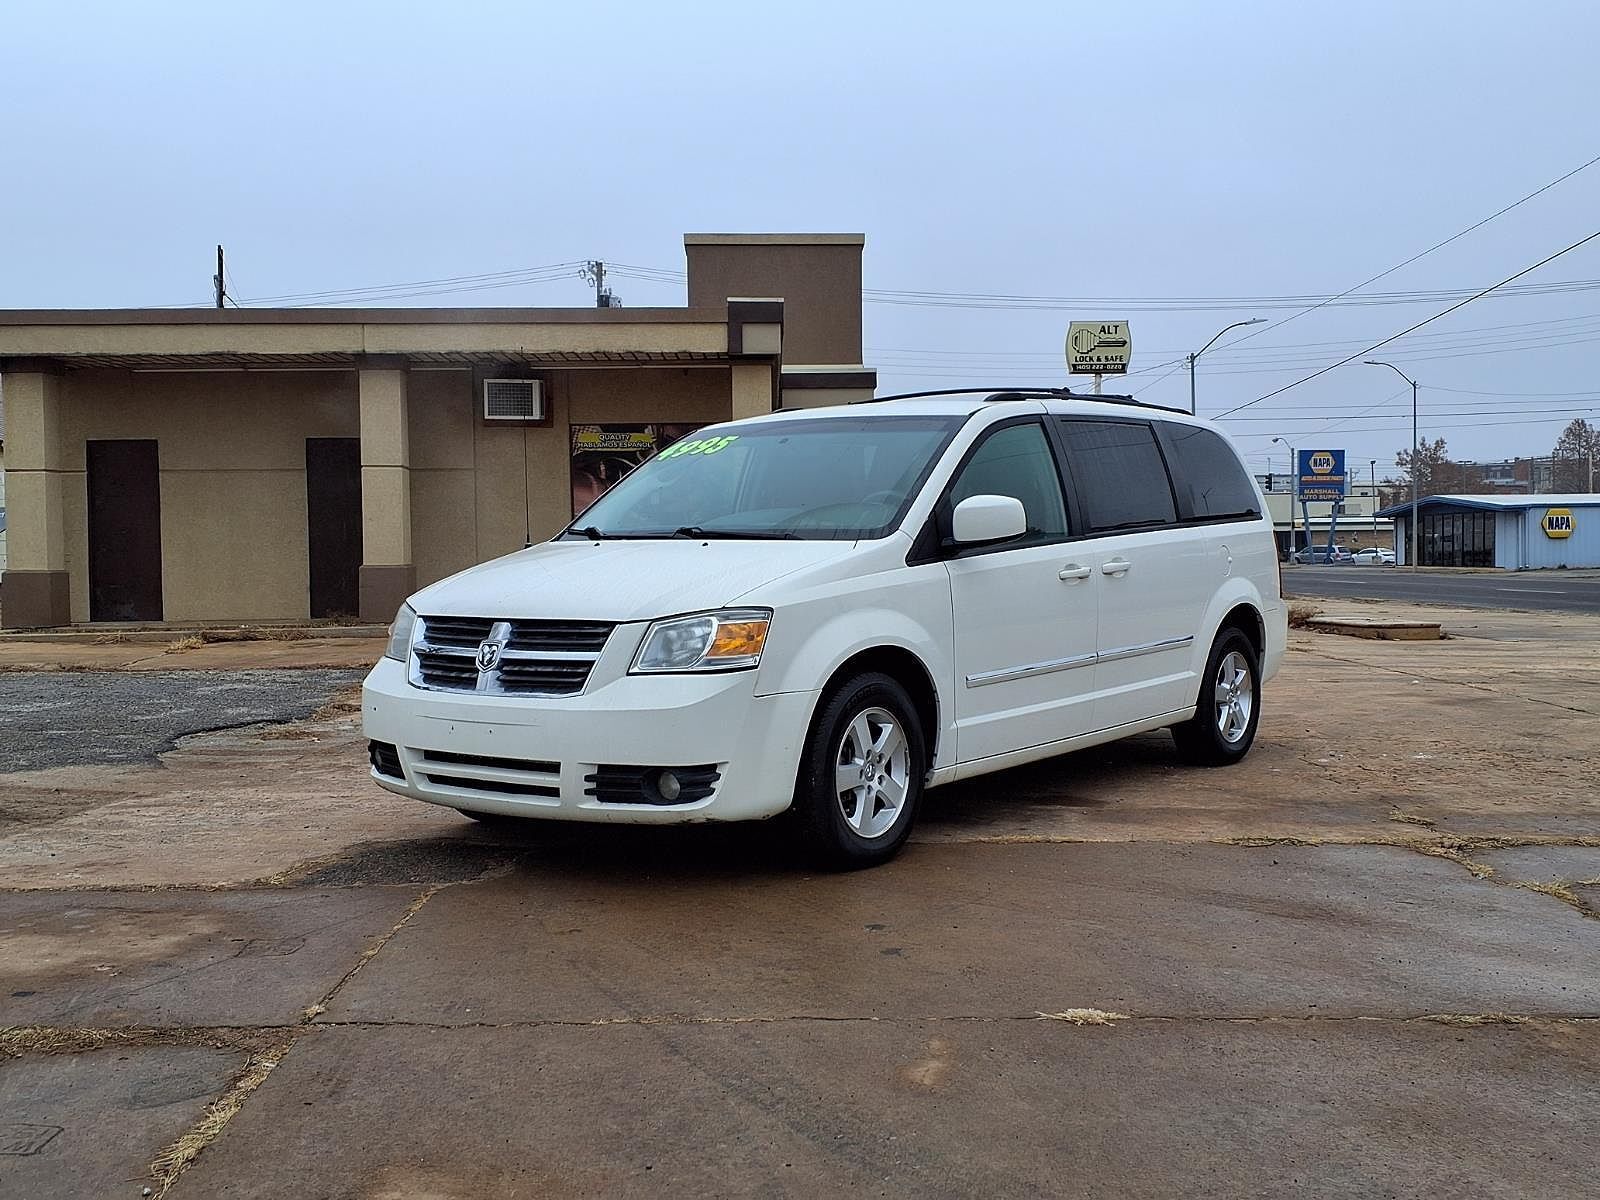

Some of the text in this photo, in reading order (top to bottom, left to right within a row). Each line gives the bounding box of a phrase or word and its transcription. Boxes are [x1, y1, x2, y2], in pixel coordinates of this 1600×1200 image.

[1099, 325, 1119, 334] ALT
[1313, 457, 1330, 468] NAPA
[1548, 516, 1570, 530] NAPA
